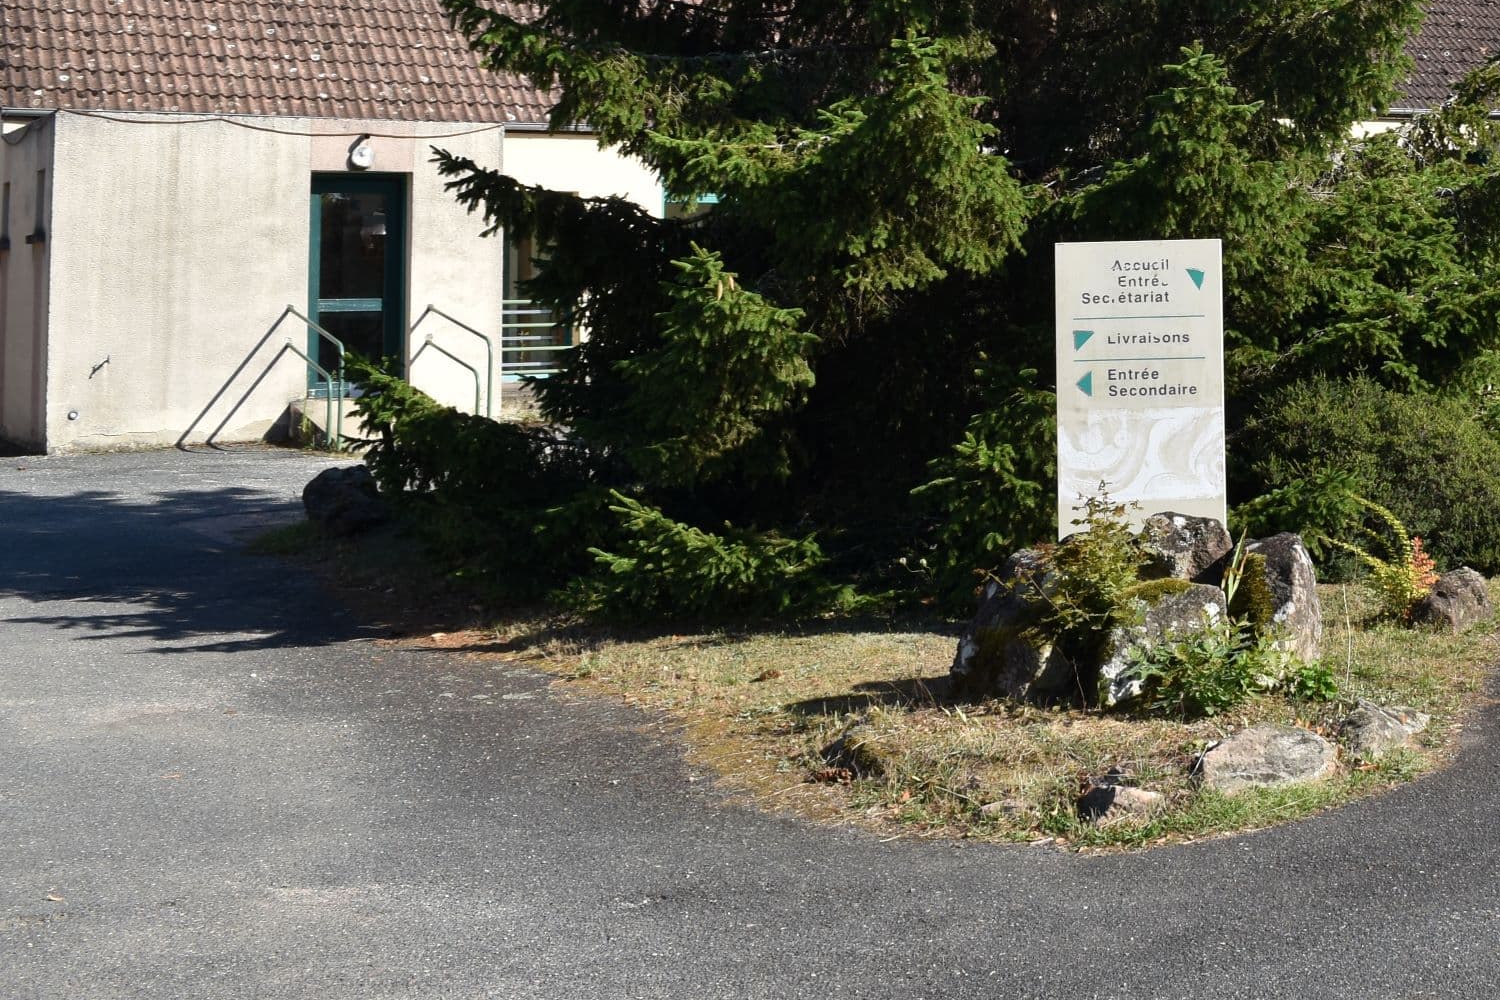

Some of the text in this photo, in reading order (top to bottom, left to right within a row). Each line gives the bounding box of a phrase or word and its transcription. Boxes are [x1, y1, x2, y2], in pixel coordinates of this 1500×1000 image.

[1081, 291, 1170, 304] Secétariat
[1107, 332, 1190, 344] Livraisons
[1108, 368, 1159, 380] Entrée
[1108, 383, 1198, 396] Secondaire
